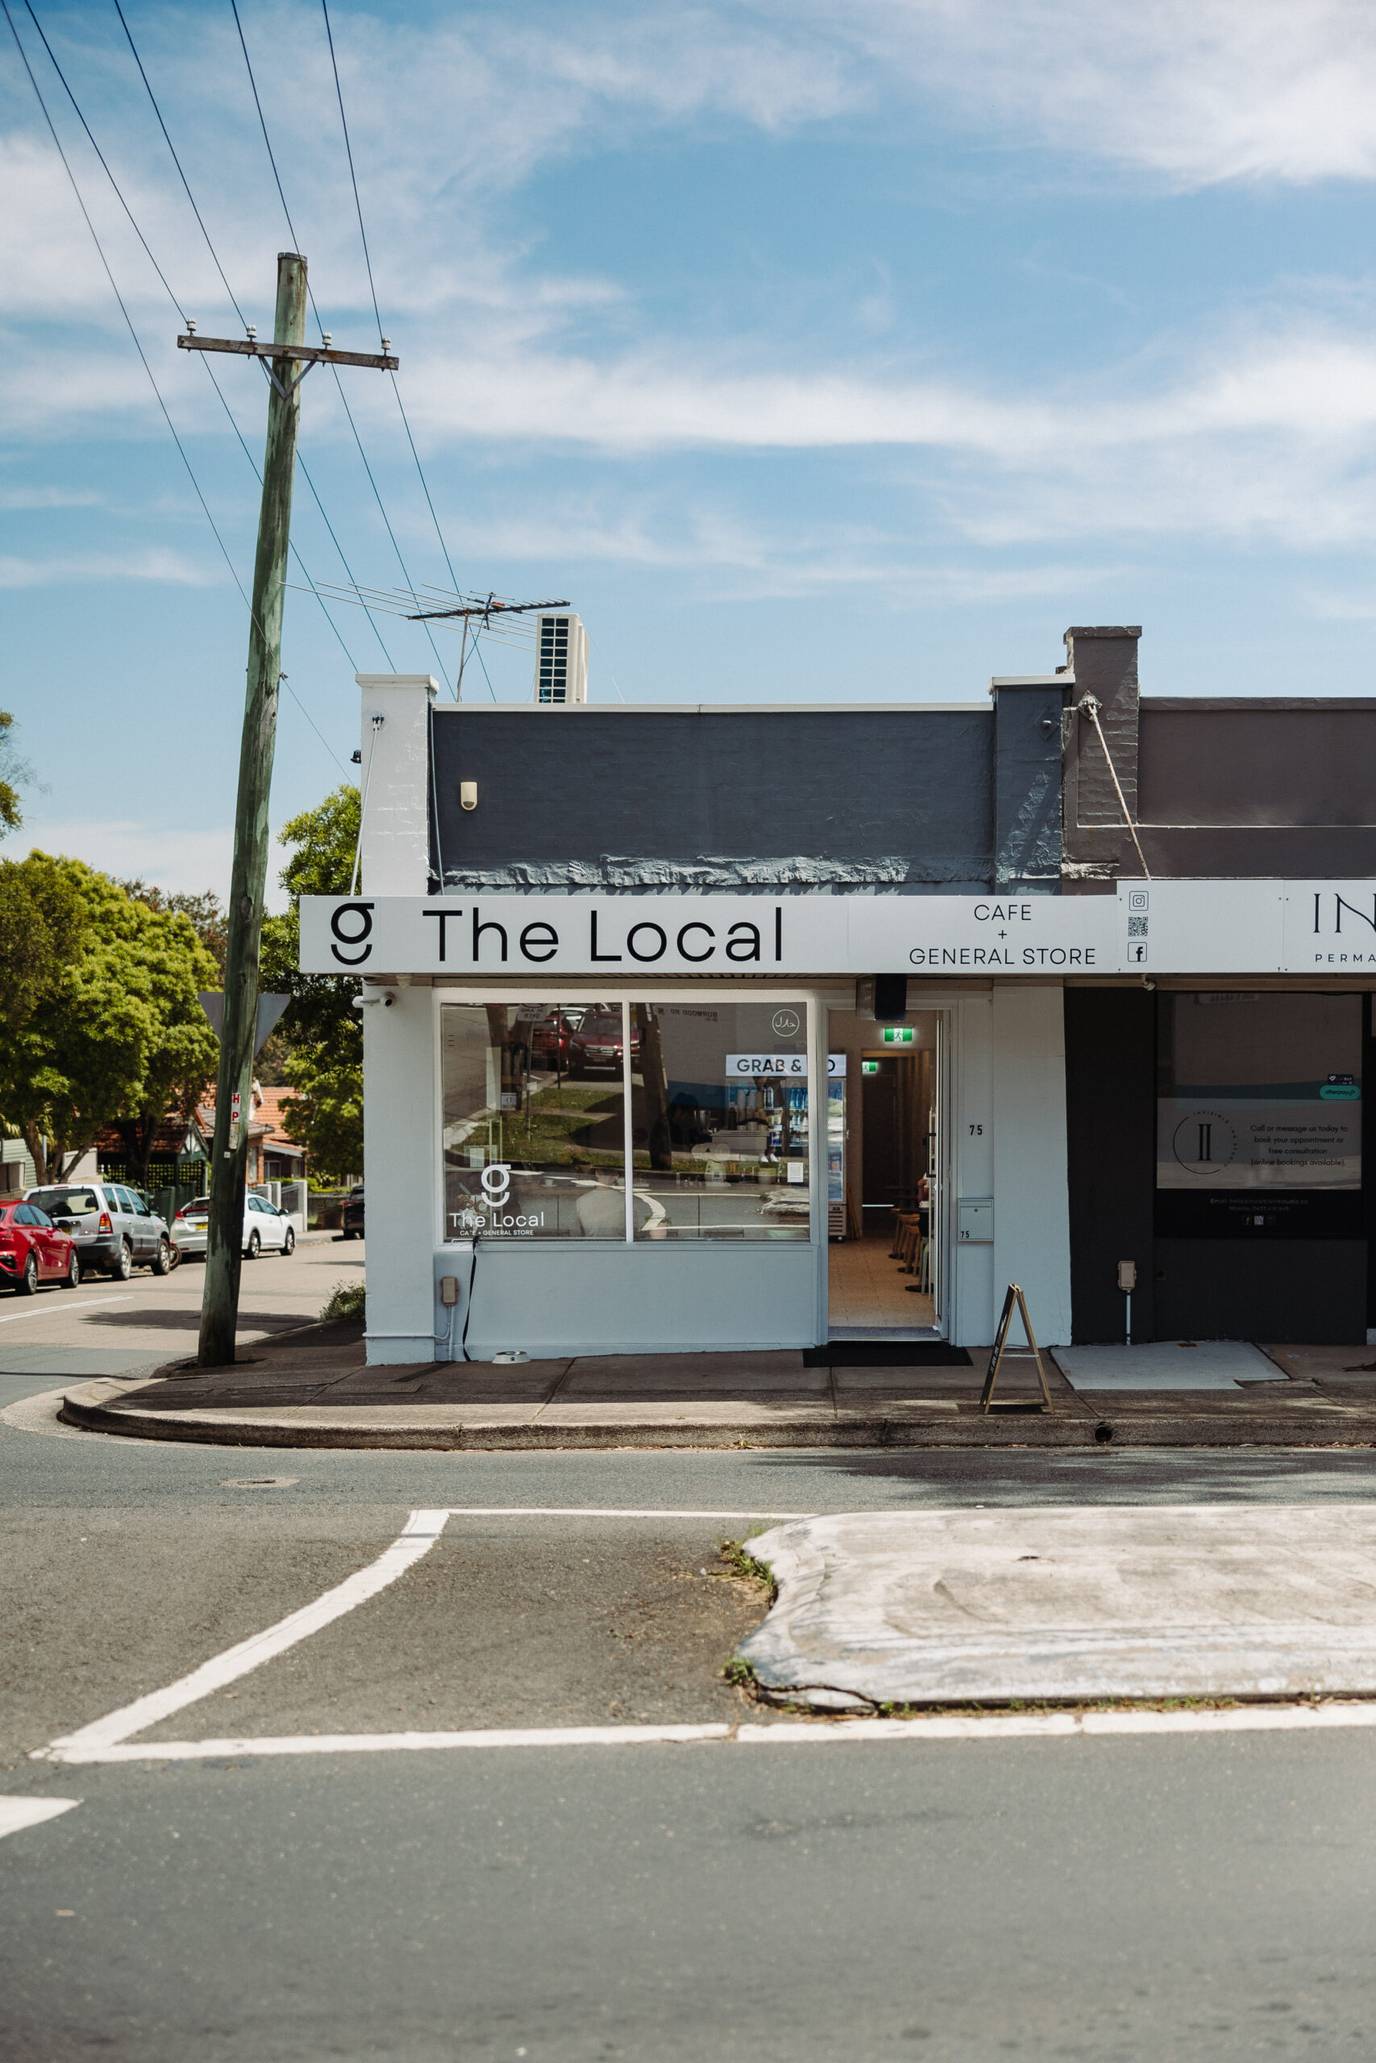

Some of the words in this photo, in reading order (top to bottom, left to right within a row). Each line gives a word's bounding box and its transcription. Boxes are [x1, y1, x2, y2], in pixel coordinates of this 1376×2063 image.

[974, 904, 1032, 921] CAFE
[330, 902, 375, 966] g
[422, 906, 559, 963] The
[590, 906, 782, 963] Local
[909, 948, 1015, 965] GENERAL
[1022, 947, 1096, 965] STORE
[736, 1058, 785, 1072] GRAB
[790, 1058, 802, 1072] &
[969, 1124, 983, 1136] 75
[1275, 1126, 1307, 1134] message
[1318, 1124, 1338, 1134] today
[1254, 1135, 1271, 1143] book
[1273, 1137, 1289, 1145] your
[1290, 1136, 1335, 1145] appointment
[1276, 1158, 1307, 1167] bookings
[481, 1164, 512, 1207] g
[449, 1212, 486, 1227] The
[493, 1211, 545, 1227] Local
